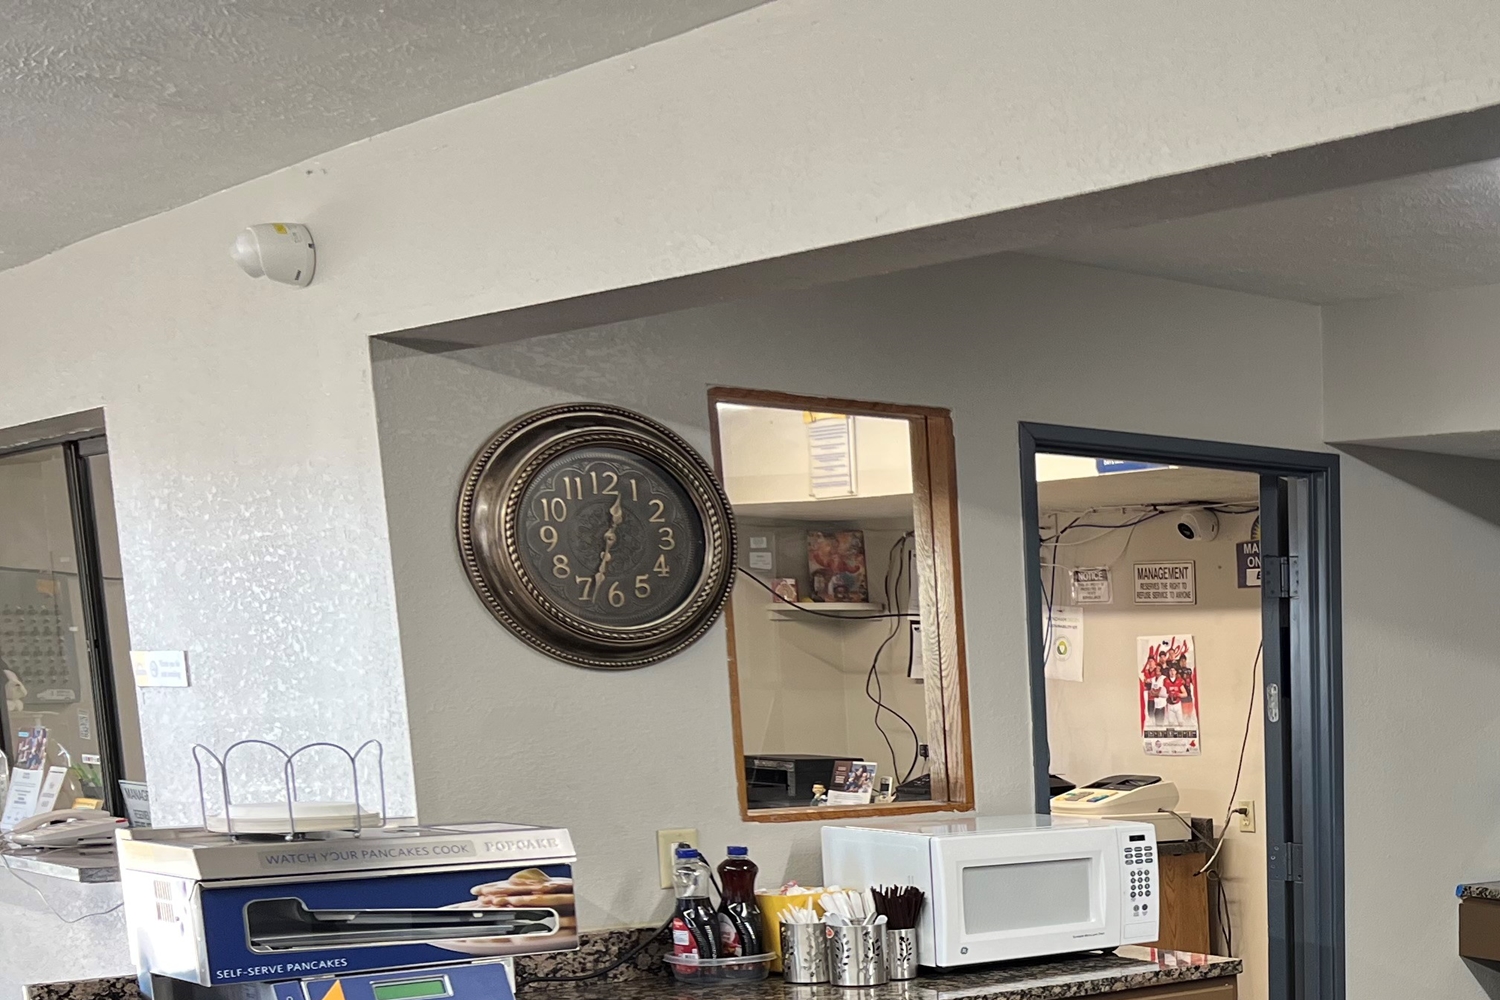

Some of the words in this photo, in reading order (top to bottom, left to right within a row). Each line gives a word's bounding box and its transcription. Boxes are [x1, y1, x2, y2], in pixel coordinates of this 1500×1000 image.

[563, 476, 583, 500] 11
[589, 471, 619, 495] 12
[630, 478, 638, 501] 1
[541, 498, 567, 522] 10
[648, 500, 665, 522] 2
[539, 525, 558, 552] 9
[658, 527, 675, 550] 3
[552, 554, 570, 578] 8
[653, 554, 670, 577] 4
[1078, 570, 1104, 581] NOTICE
[1137, 566, 1189, 580] MANAGEMENT
[575, 575, 593, 600] 7
[608, 581, 625, 607] 6
[634, 574, 650, 598] 5
[1136, 591, 1151, 600] REFUSE
[1152, 591, 1168, 600] SERVICE
[1169, 591, 1175, 599] TO
[1176, 590, 1191, 599] ANYONE
[1140, 582, 1160, 591] RESERVES
[1160, 582, 1168, 590] THE
[1169, 582, 1181, 590] RIGHT
[1181, 582, 1187, 590] TO
[265, 851, 317, 866] WATCH
[318, 849, 357, 863] YOUR
[360, 846, 430, 861] PANCAKES
[432, 843, 469, 856] COOK
[216, 963, 285, 980] SELF-SERVE
[286, 958, 348, 973] PANCAKES
